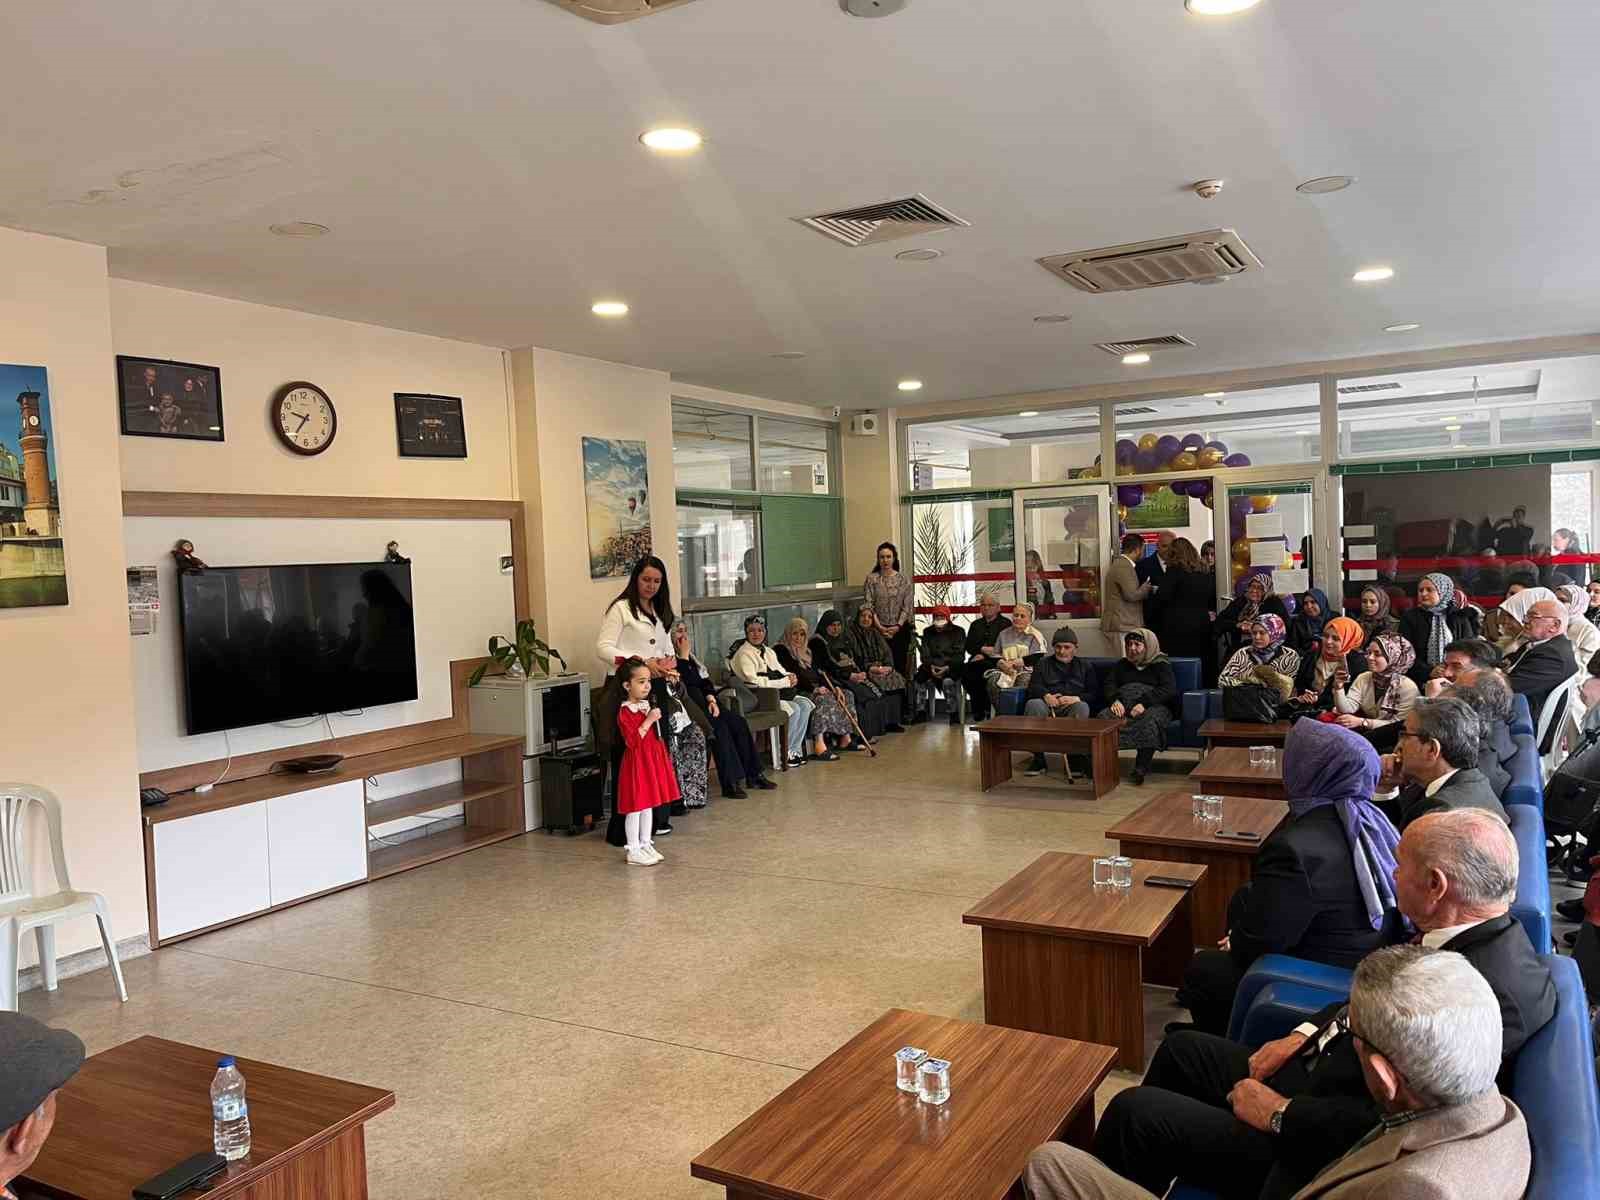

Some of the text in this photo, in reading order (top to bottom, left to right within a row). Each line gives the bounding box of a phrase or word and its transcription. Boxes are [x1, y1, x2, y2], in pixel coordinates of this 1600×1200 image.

[300, 392, 308, 400] 12
[284, 402, 291, 410] 10
[322, 416, 328, 424] 3
